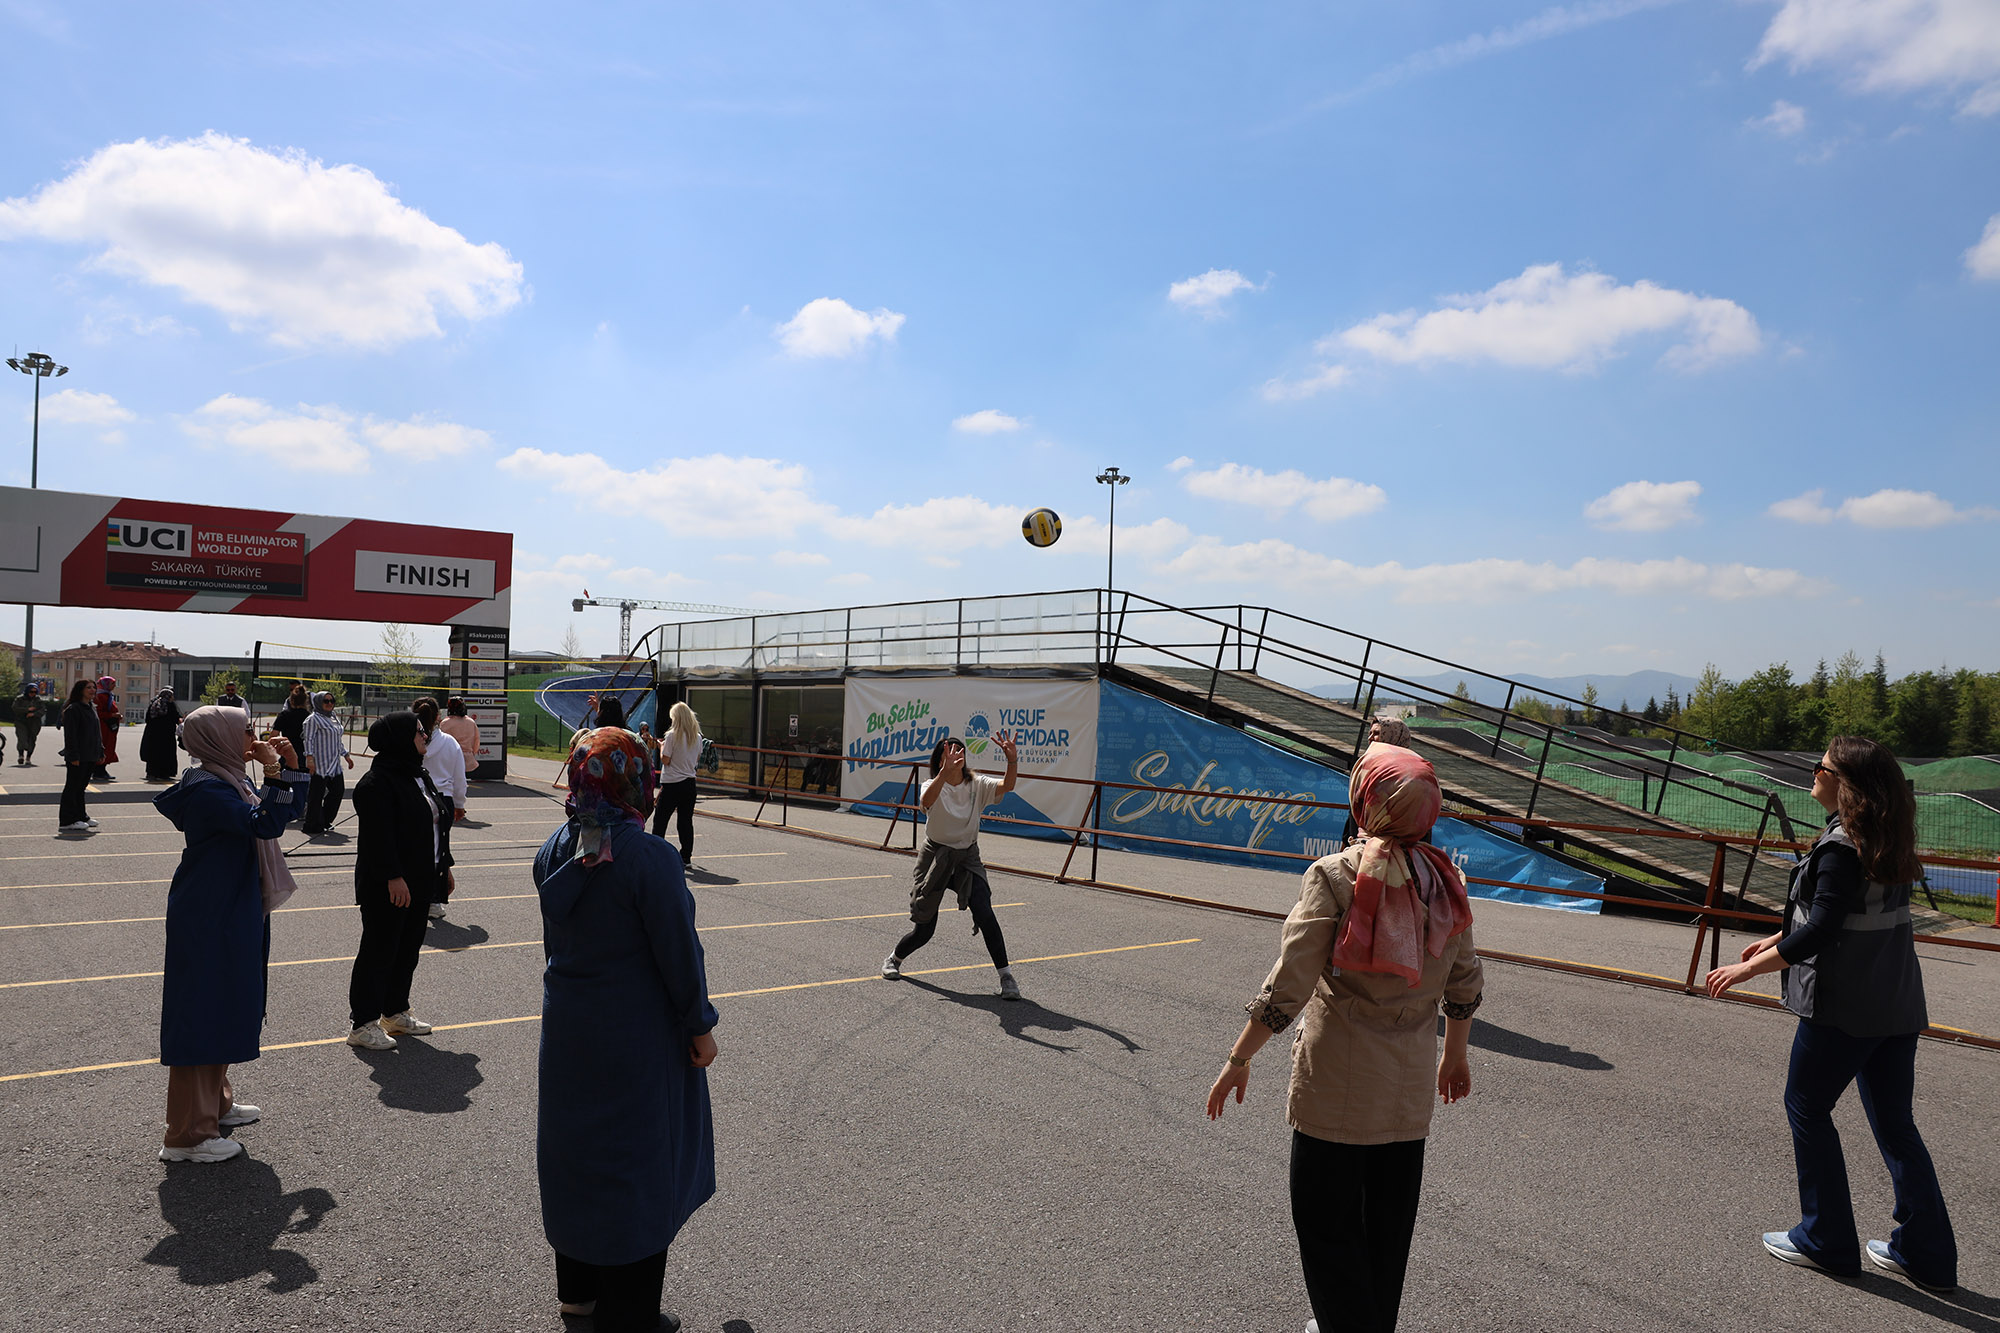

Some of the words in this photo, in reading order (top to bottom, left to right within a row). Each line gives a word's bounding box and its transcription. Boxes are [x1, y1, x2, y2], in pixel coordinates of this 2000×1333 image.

[122, 525, 186, 551] UCI
[198, 531, 224, 541] MTB
[227, 534, 298, 547] ELIMINATOR
[198, 543, 242, 555] WORLD
[245, 547, 269, 557] CUP
[151, 561, 205, 575] SAKARYA
[216, 564, 262, 578] TÜRKİYE
[386, 564, 470, 588] FINISH
[866, 712, 886, 733] Bu
[887, 699, 930, 731] Şehir
[999, 709, 1046, 726] YUSUF
[1107, 750, 1320, 857] Sakarya
